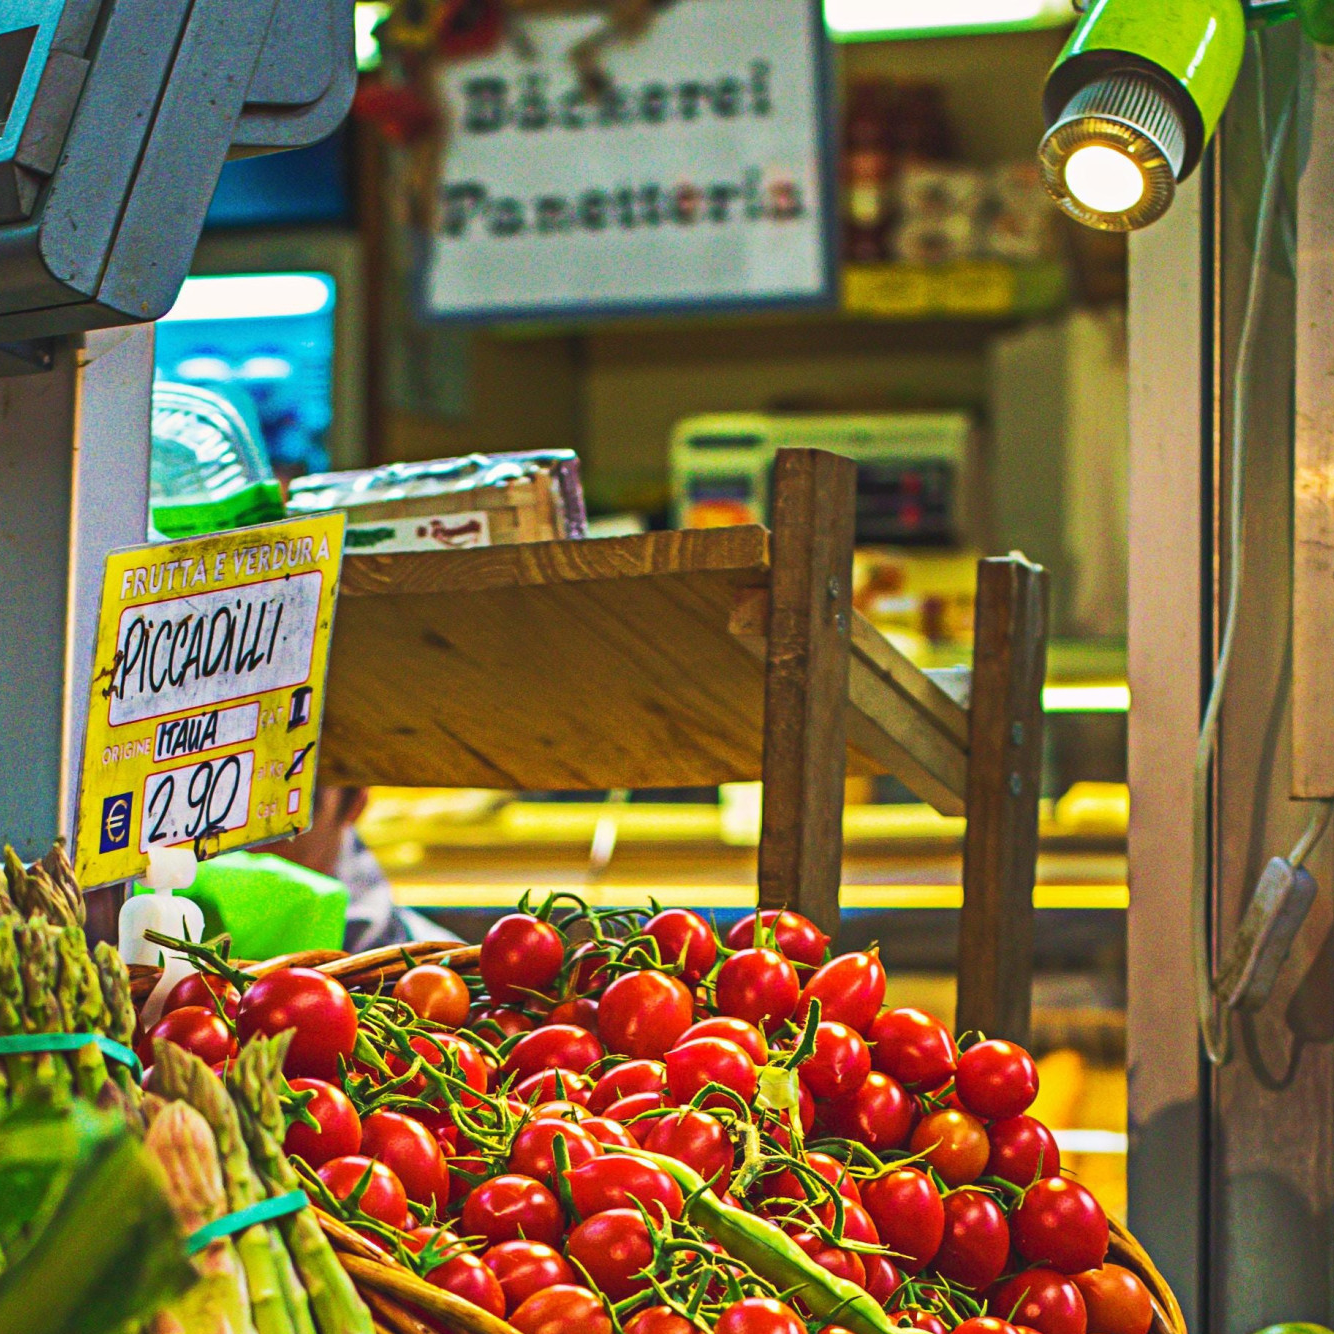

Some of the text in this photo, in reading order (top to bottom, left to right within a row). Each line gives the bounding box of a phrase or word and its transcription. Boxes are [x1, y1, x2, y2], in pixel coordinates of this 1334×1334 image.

[119, 556, 208, 600] FRUTTA
[213, 551, 228, 582] E
[232, 533, 331, 577] VERDURA
[101, 737, 153, 766] ORIGINE
[147, 754, 241, 843] 2.90
